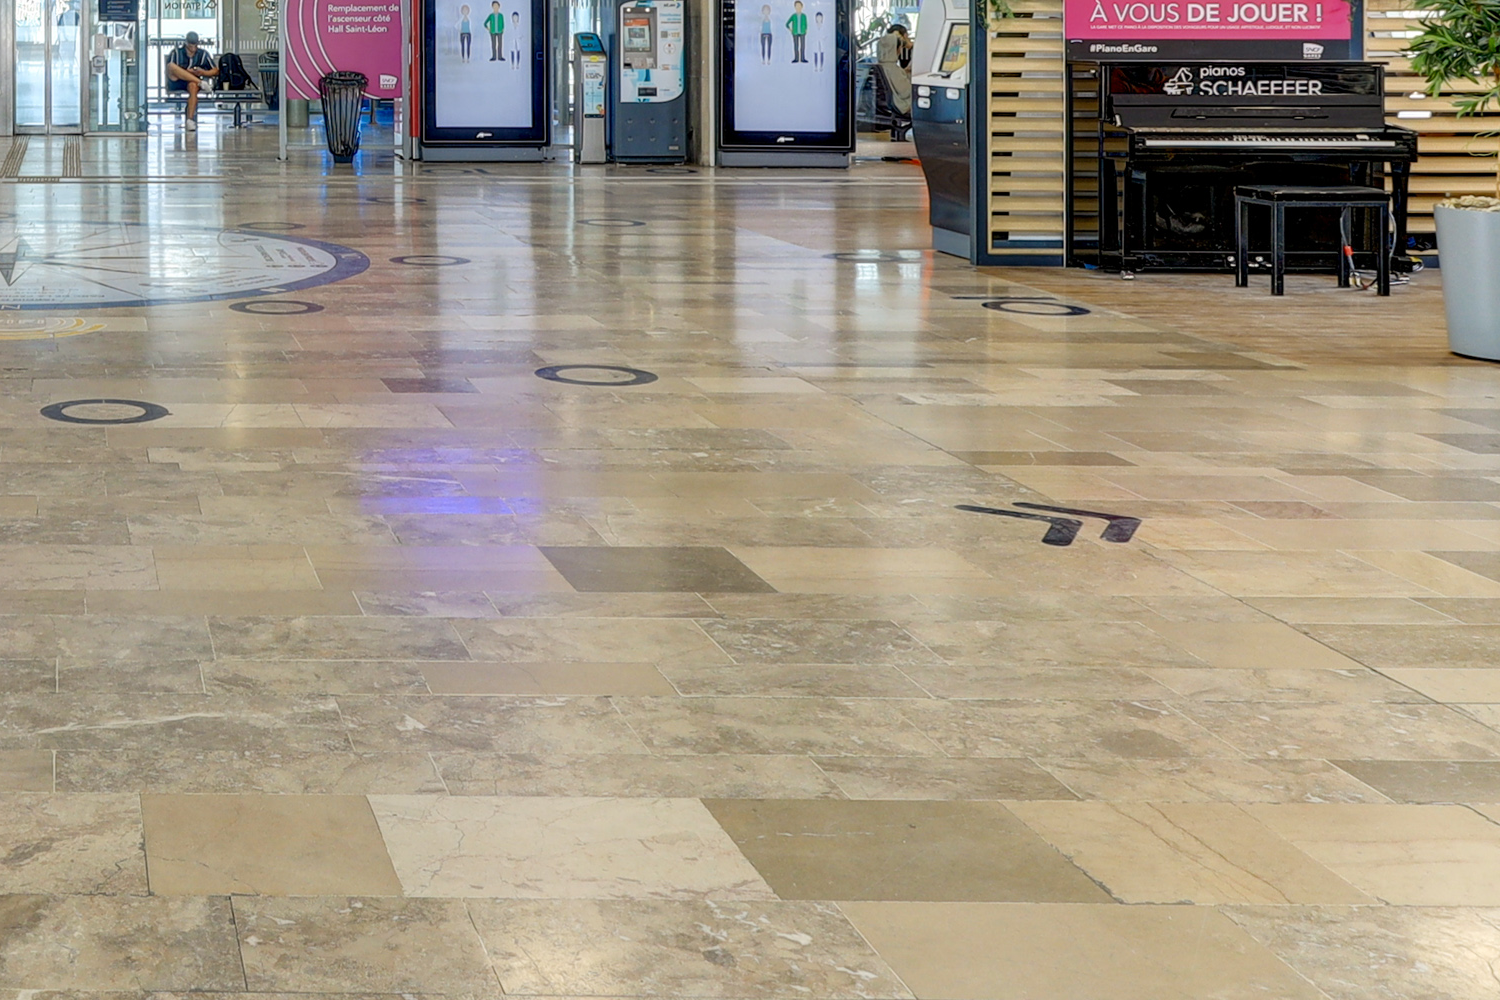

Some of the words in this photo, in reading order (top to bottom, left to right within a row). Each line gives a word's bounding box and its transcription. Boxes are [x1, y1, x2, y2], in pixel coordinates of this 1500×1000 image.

[328, 4, 387, 14] Remplacement
[389, 4, 399, 12] de
[1090, 0, 1108, 23] À
[1113, 3, 1180, 23] VOUS
[1187, 3, 1220, 23] DE
[1227, 3, 1308, 23] JOUER
[1316, 3, 1322, 23] !
[328, 14, 371, 22] l'ascenseur
[373, 14, 390, 22] côté
[345, 24, 387, 32] Saint-Léon
[1090, 44, 1157, 53] #PianoEnGare
[1200, 66, 1245, 79] pianos
[1199, 80, 1322, 95] SCHAEFFER
